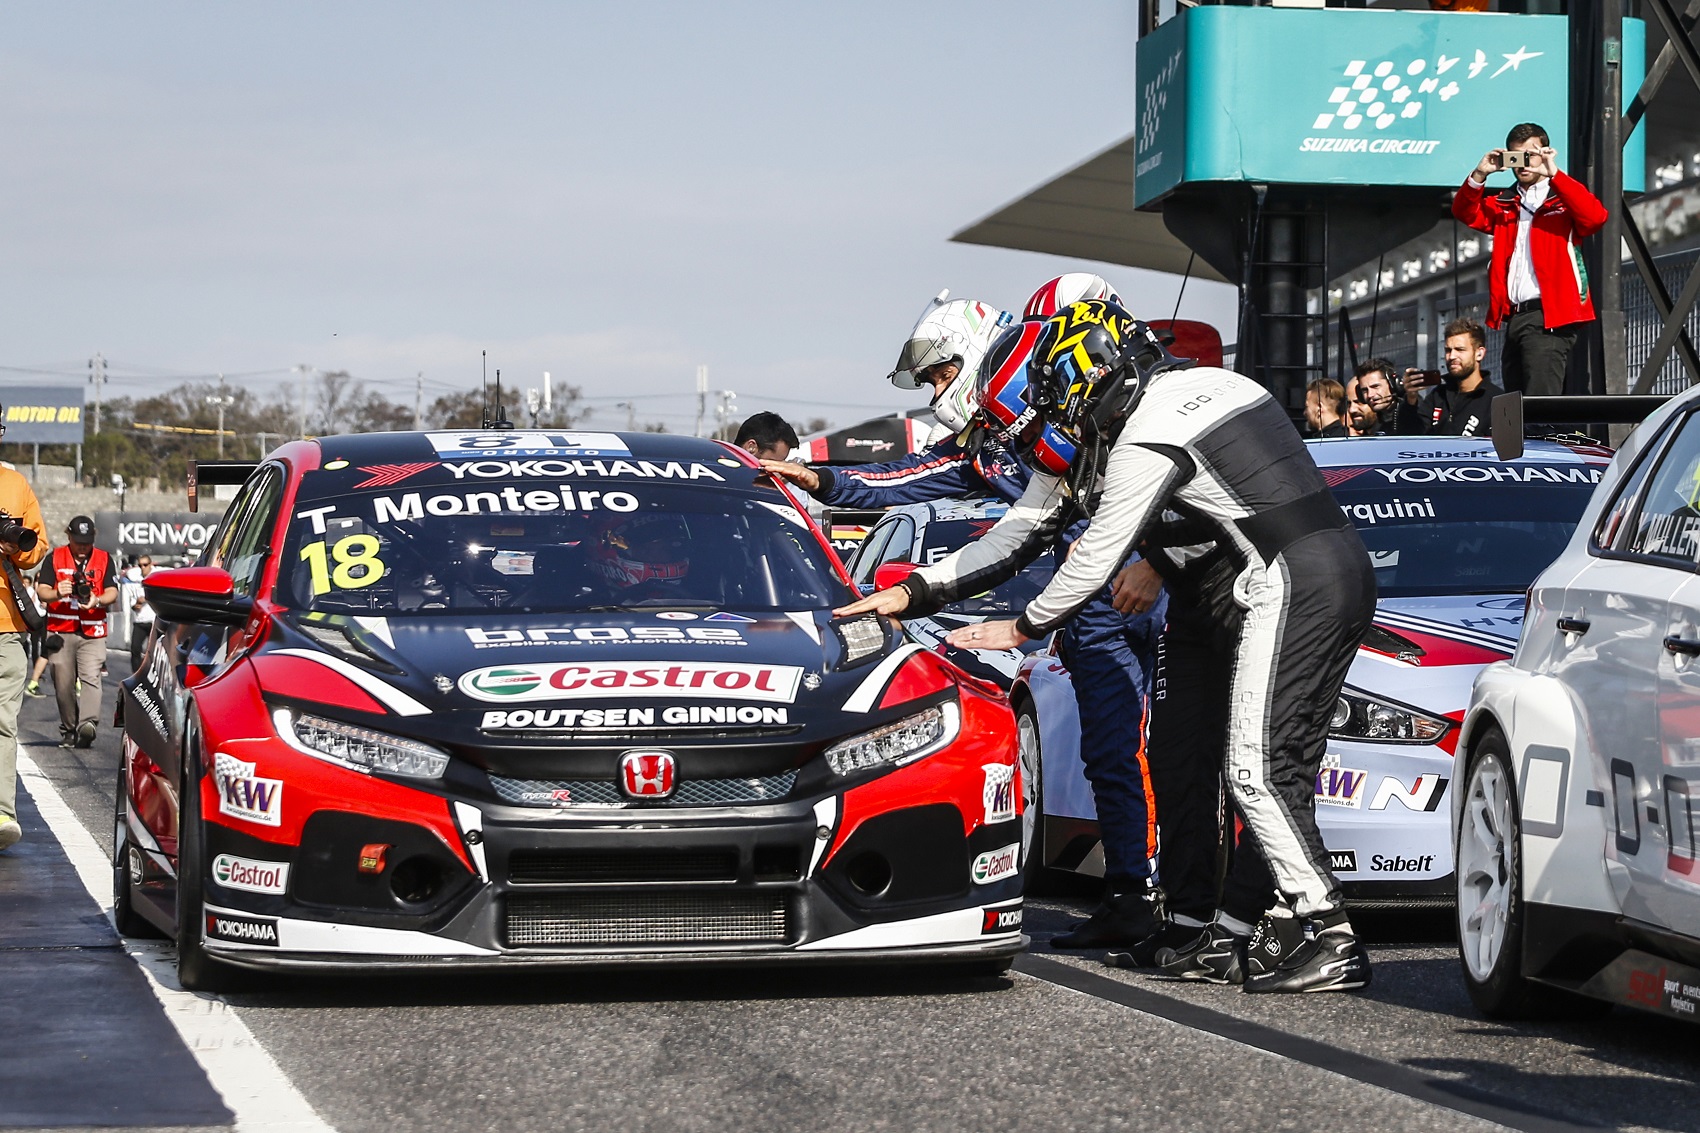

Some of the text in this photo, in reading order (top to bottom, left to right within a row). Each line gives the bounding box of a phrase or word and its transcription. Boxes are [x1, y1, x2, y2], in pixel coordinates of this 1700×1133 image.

[1299, 137, 1441, 155] SUZUKA CIRCUIT
[6, 405, 80, 424] MOTOR OIL
[1006, 406, 1038, 436] RACING
[1397, 451, 1489, 459] Sabelt
[441, 460, 727, 482] YOKOHAMA
[297, 505, 353, 535] T.
[372, 484, 641, 525] Monteiro
[1341, 497, 1436, 524] rquini
[300, 534, 385, 595] 18
[464, 627, 743, 644] brose
[474, 640, 582, 649] Excellence
[549, 667, 776, 692] Castrol
[481, 706, 788, 728] BOUTSEN GINION
[225, 775, 278, 814] KW
[551, 789, 572, 802] R
[1315, 797, 1355, 807] spensions.de
[987, 848, 1014, 877] Castrol
[1370, 854, 1434, 872] Sabelt
[231, 861, 282, 888] Castrol
[215, 918, 277, 941] YOKOHAMA
[1664, 979, 1680, 994] sport
[1670, 994, 1696, 1013] logistics
